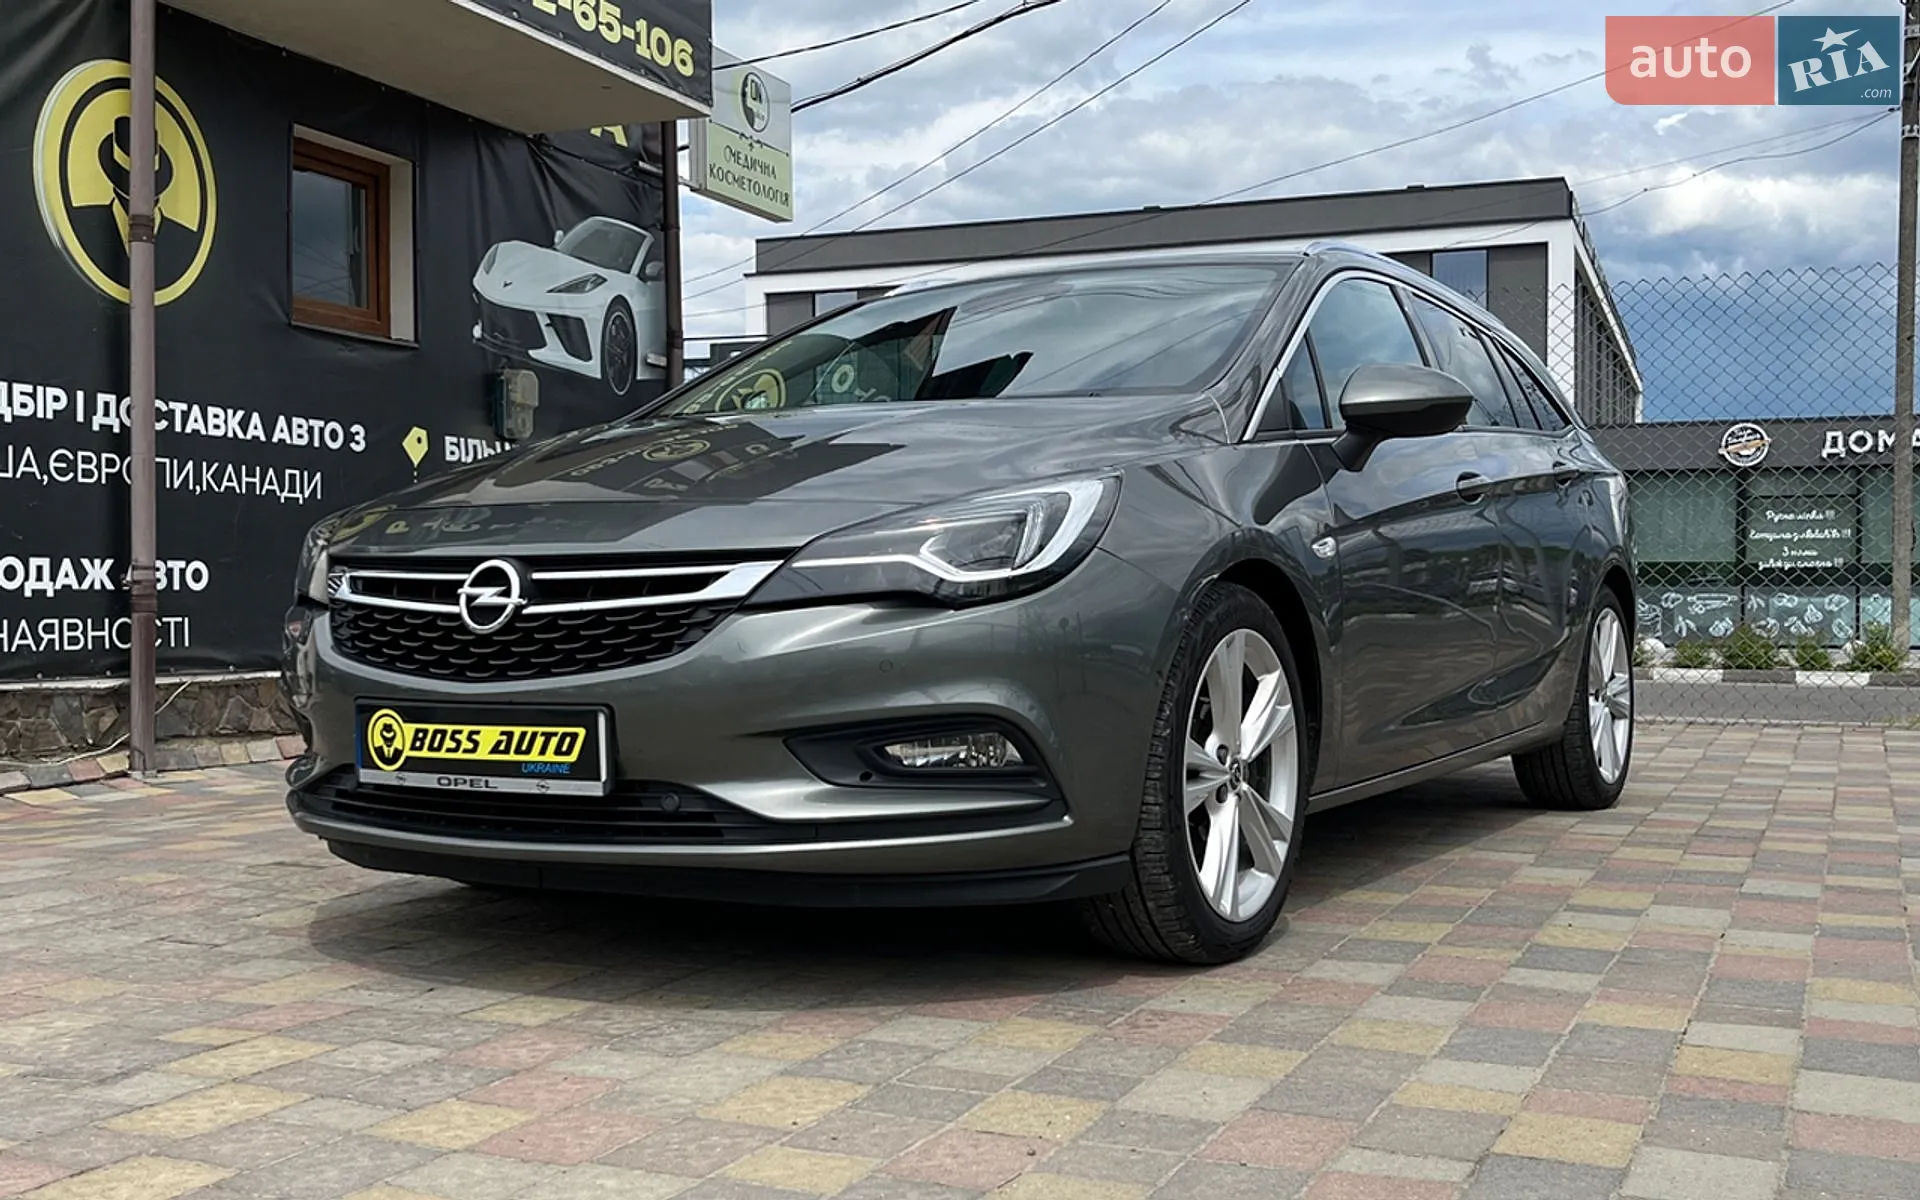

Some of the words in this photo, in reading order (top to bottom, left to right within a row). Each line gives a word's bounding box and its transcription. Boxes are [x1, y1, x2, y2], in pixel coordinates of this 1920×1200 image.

[723, 145, 777, 180] МЕДИЧНА
[709, 163, 790, 207] КОСМЕТОЛОГІЯ
[272, 415, 345, 450] АВТО
[121, 560, 210, 592] ВТО
[409, 727, 482, 755] BOSS
[488, 730, 581, 757] AUTO
[436, 776, 499, 790] OPEL
[521, 763, 572, 774] UKRAINE
